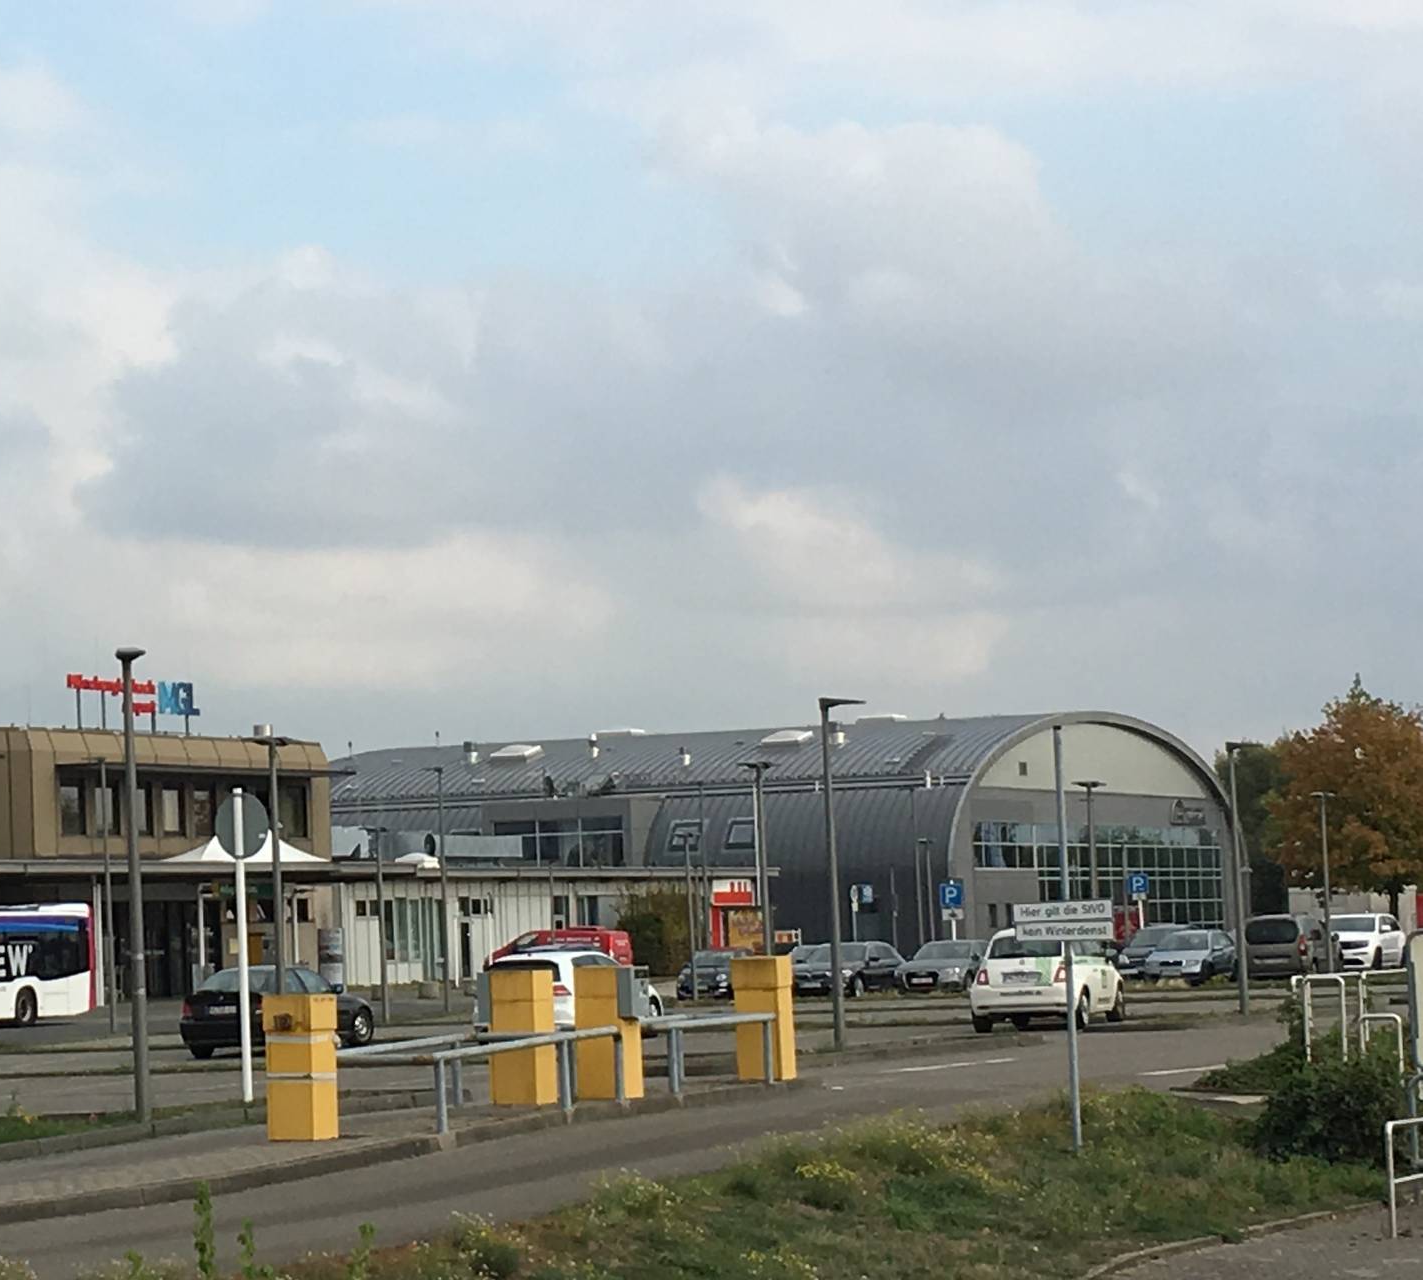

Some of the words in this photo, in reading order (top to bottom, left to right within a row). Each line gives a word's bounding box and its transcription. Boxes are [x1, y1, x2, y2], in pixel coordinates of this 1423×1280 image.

[1020, 906, 1041, 917] Hier
[1046, 906, 1061, 918] gilt
[1063, 904, 1078, 916] die
[1081, 902, 1106, 915] StVO
[1022, 927, 1043, 937] kein
[1045, 925, 1108, 936] Winterdienst
